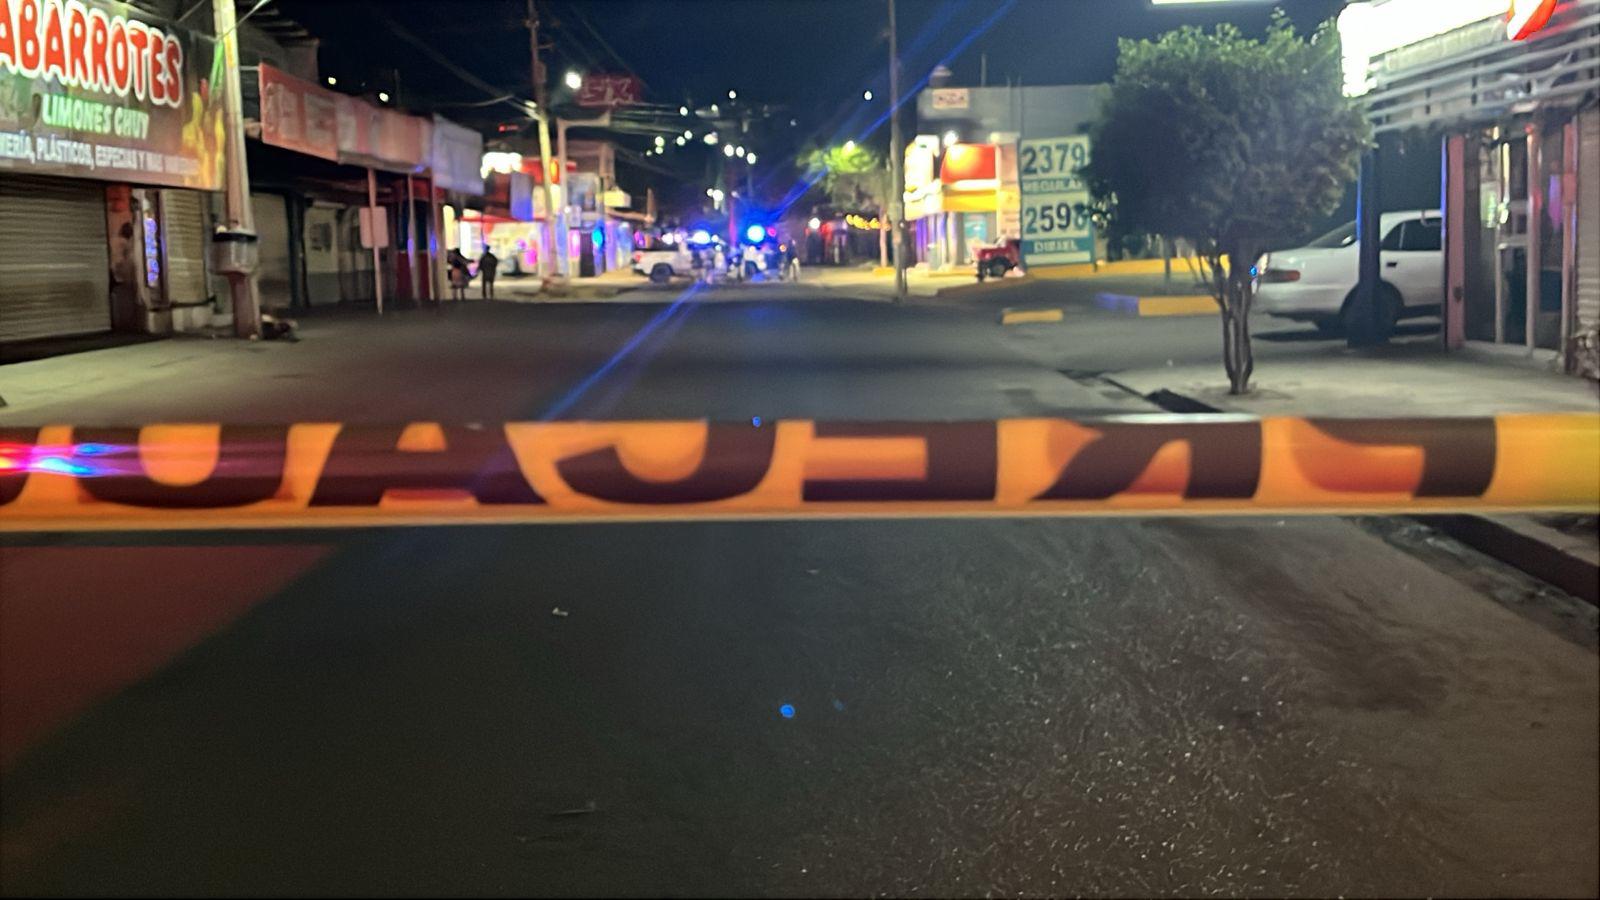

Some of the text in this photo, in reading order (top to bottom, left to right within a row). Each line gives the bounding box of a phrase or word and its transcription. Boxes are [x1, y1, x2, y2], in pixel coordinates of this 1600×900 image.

[42, 93, 149, 140] LIMONES CHUY
[1022, 142, 1086, 175] 2379
